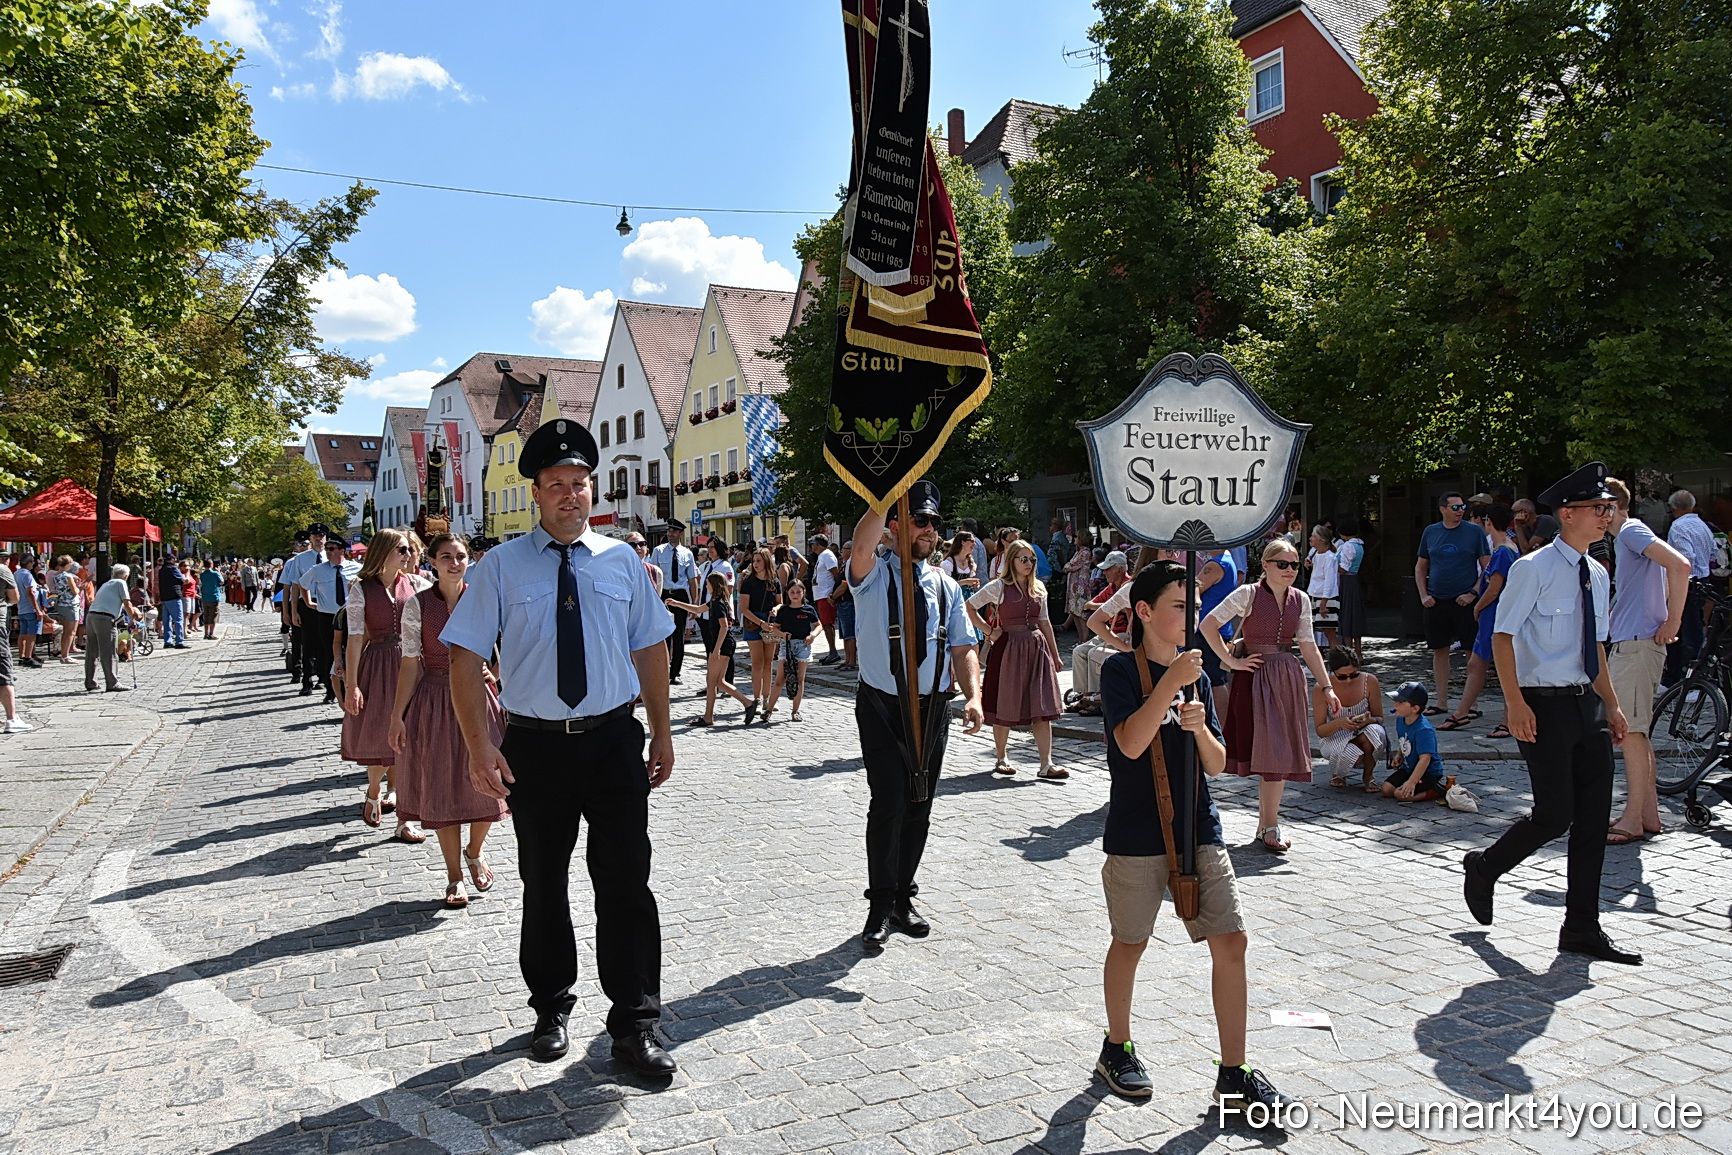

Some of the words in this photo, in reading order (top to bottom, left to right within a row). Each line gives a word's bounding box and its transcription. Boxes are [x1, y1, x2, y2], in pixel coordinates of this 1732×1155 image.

[892, 171, 915, 190] toten
[863, 184, 914, 215] Kameraden
[870, 229, 898, 248] Stauf
[841, 352, 904, 373] Stauf
[1153, 406, 1236, 427] Freiwillige
[1123, 422, 1272, 452] Feuerwehr
[1125, 456, 1266, 507] Stauf
[693, 511, 701, 524] P
